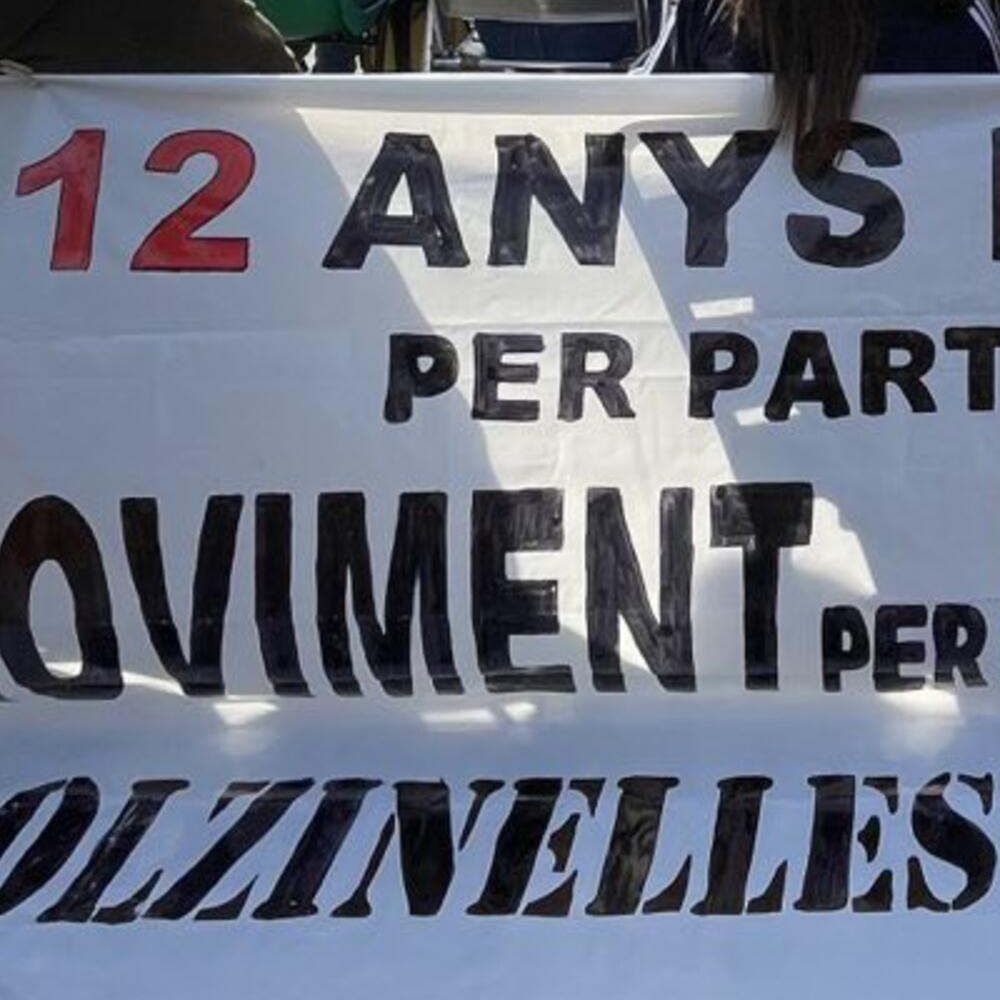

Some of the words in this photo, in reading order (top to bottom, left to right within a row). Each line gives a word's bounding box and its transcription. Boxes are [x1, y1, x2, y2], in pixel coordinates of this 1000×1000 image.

[17, 128, 257, 272] 12
[322, 121, 906, 271] ANYS
[382, 333, 636, 424] PER
[0, 482, 814, 701] OVIMENT
[821, 603, 989, 692] PER
